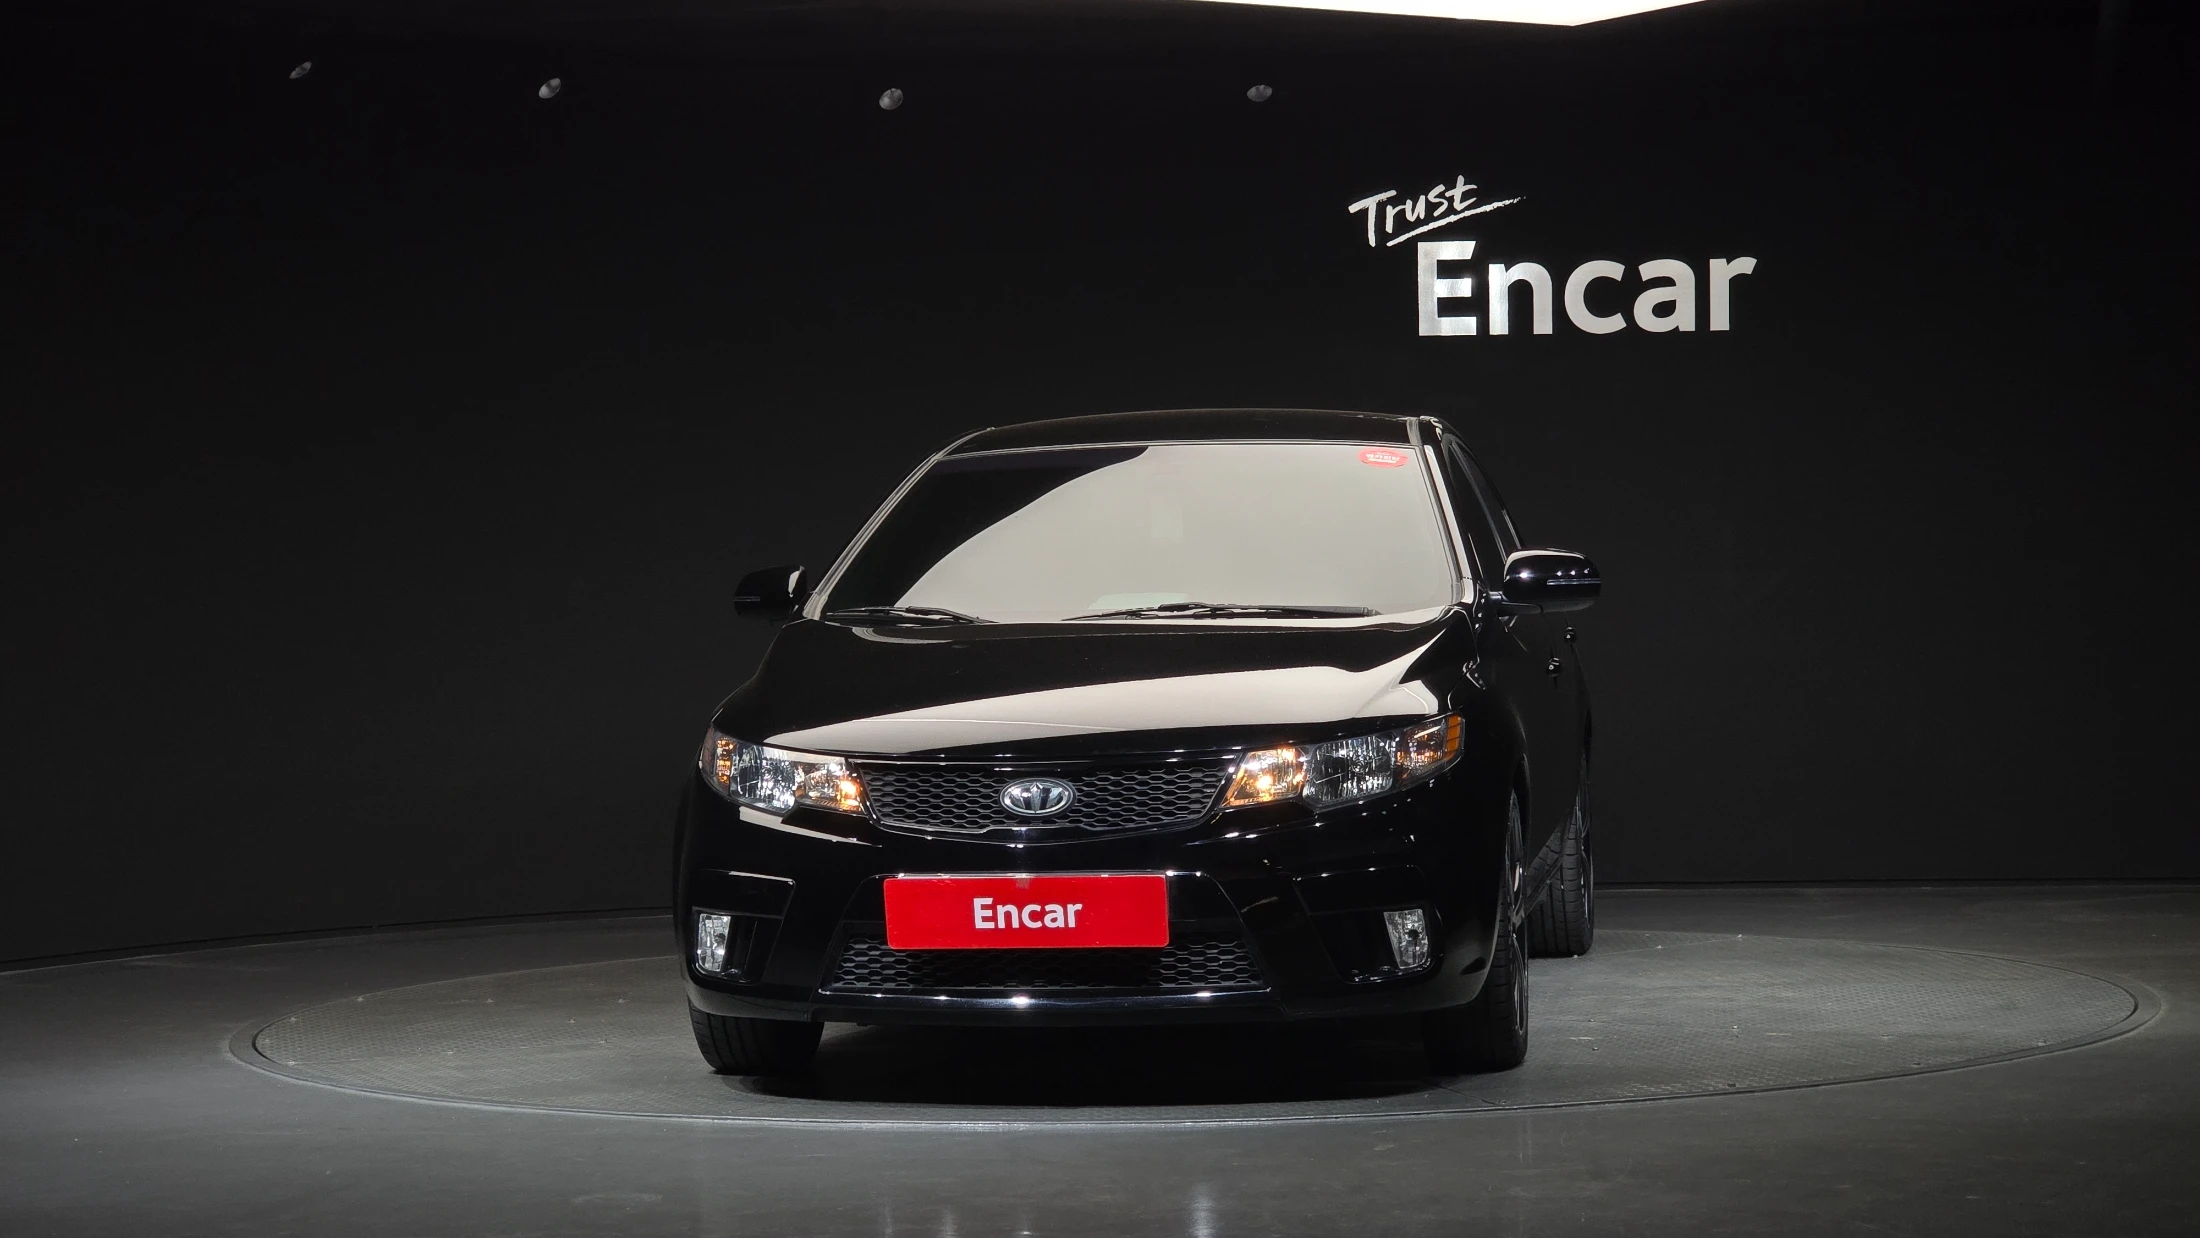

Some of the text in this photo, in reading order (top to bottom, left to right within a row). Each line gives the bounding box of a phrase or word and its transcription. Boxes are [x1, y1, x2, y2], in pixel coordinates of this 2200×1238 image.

[1348, 174, 1478, 247] Trust
[1417, 240, 1758, 336] Encar
[973, 897, 1083, 929] Encar
